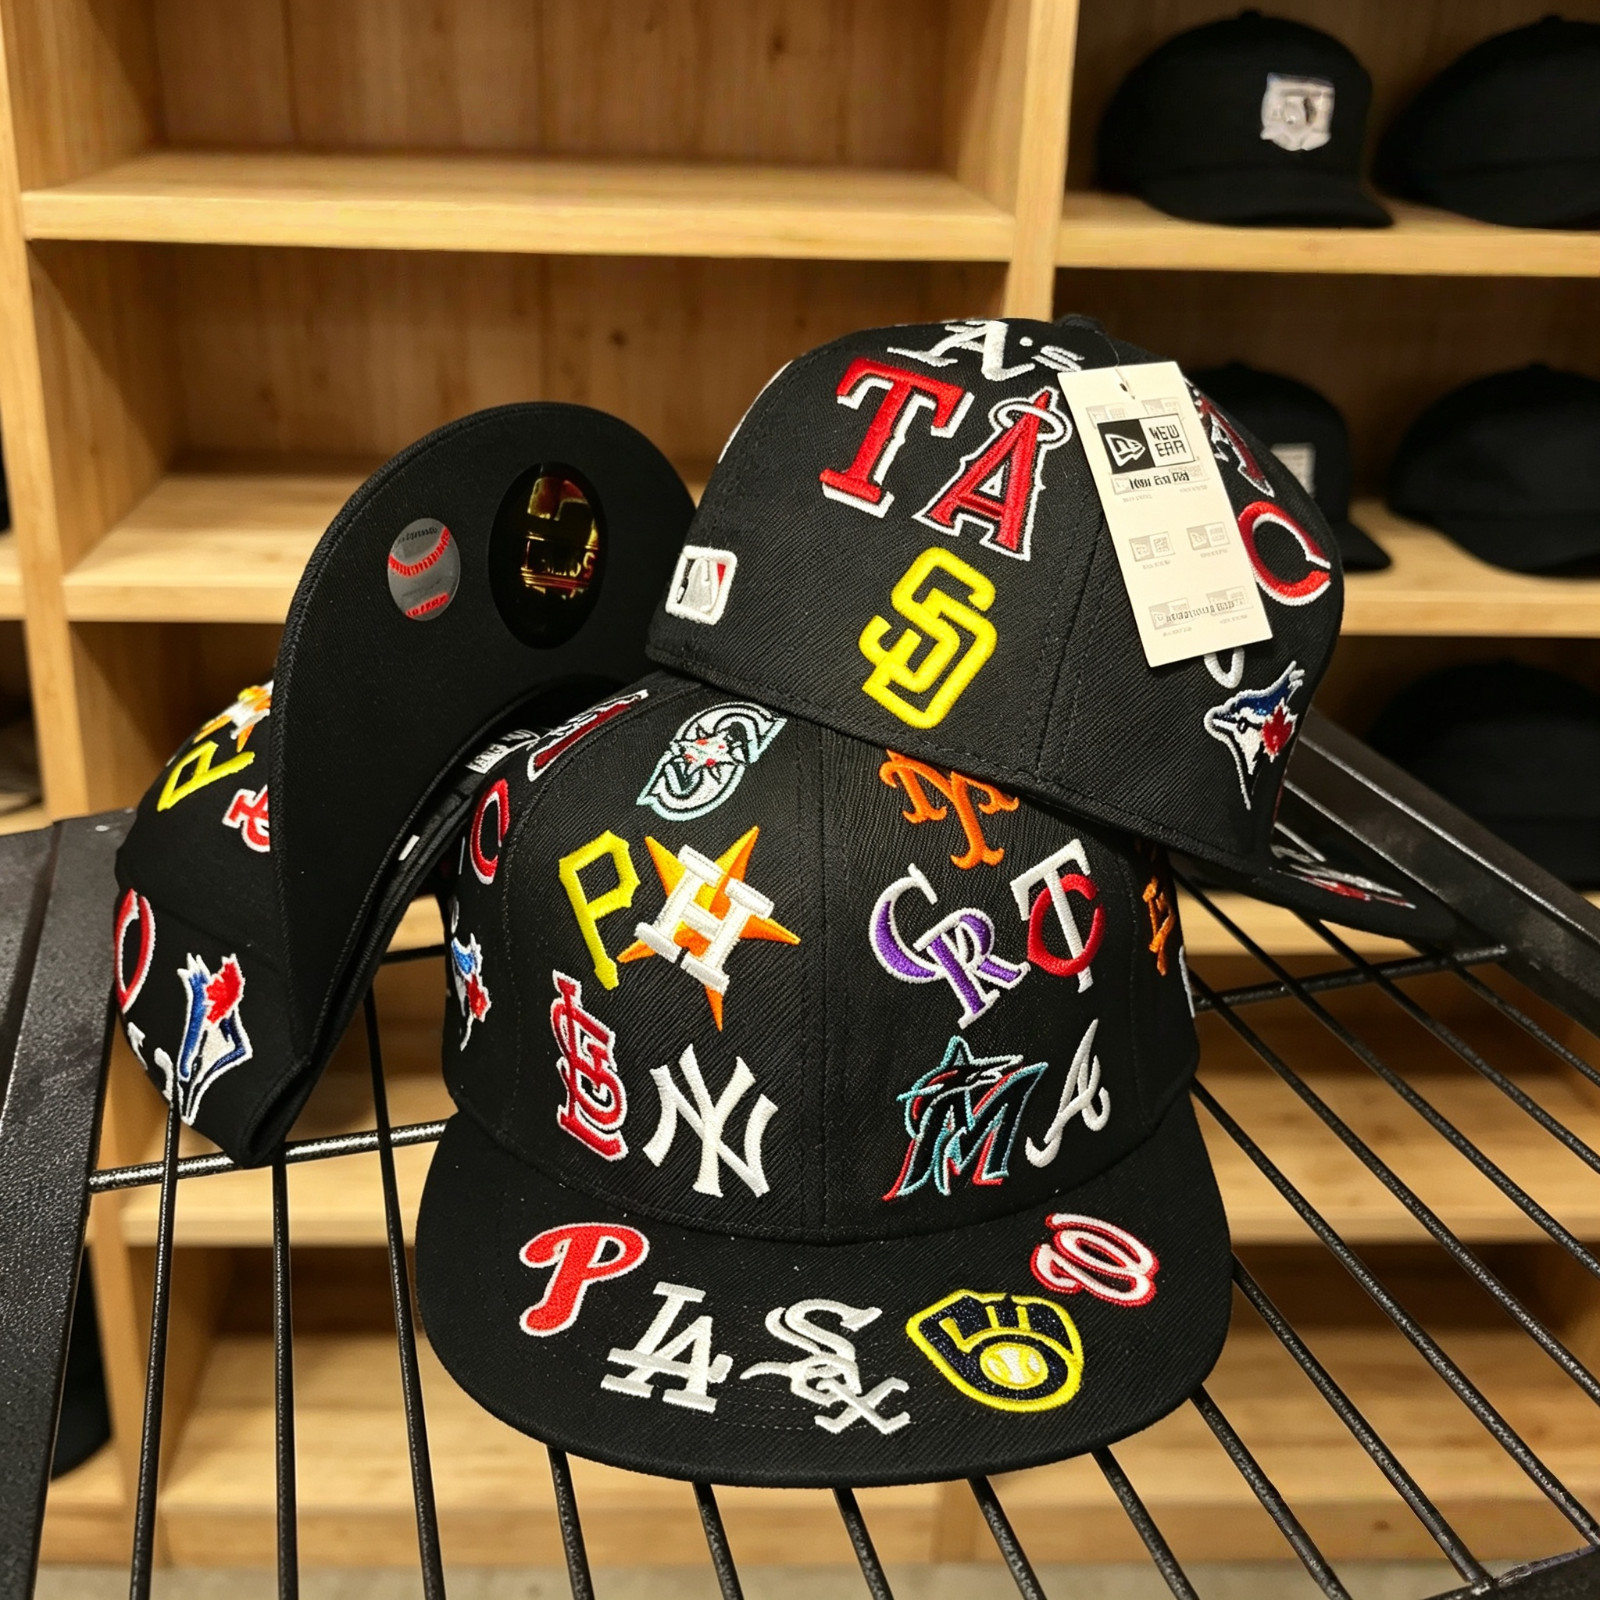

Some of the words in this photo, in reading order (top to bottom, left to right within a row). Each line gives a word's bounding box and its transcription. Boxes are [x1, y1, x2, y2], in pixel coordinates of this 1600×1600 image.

[818, 357, 975, 519] T
[912, 386, 1073, 561] A
[1238, 501, 1331, 606] C
[858, 546, 998, 729] SD
[558, 829, 641, 991] P
[634, 843, 775, 993] H
[868, 862, 1031, 1030] CR
[642, 1043, 779, 1198] NY
[1024, 1018, 1111, 1168] A
[518, 1221, 651, 1337] P
[599, 1281, 735, 1413] LA
